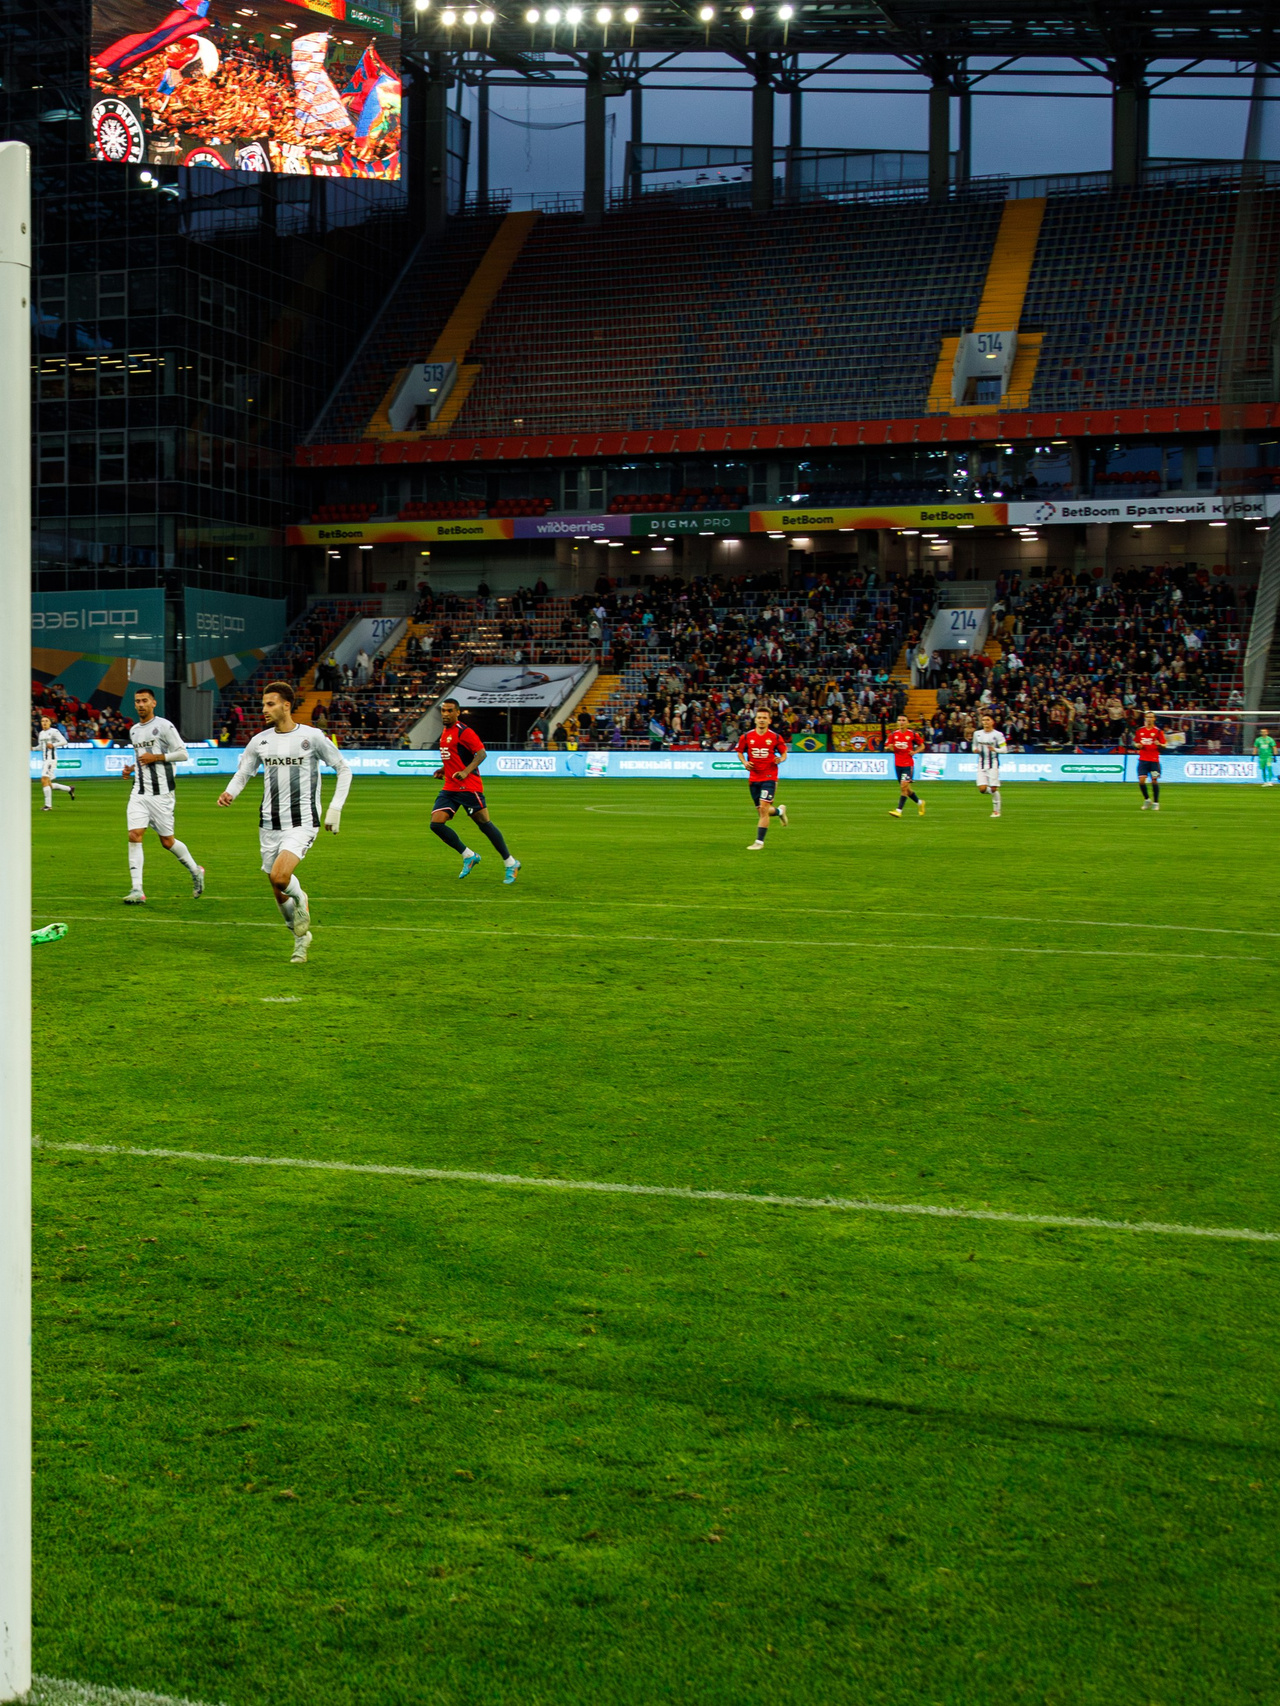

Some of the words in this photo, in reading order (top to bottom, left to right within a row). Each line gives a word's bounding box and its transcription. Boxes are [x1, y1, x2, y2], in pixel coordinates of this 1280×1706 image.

[977, 333, 1003, 353] 514
[423, 364, 445, 382] 513
[1061, 506, 1120, 518] BetBoom
[1126, 502, 1206, 517] Братский
[1212, 502, 1264, 517] кубок
[782, 515, 834, 525] BetBoom
[920, 511, 975, 521] BetBoom
[536, 520, 606, 533] wildberries
[650, 520, 698, 529] DIGMA
[703, 518, 731, 527] PRO
[318, 529, 363, 539] BetBoom
[437, 526, 484, 535] BetBoom
[950, 610, 977, 630] 214
[371, 619, 394, 637] 213
[751, 747, 770, 758] 25
[264, 756, 305, 766] MAXBET
[363, 757, 391, 768] ВКУС
[620, 758, 671, 770] НЕЖНЫЙ
[673, 760, 704, 770] ВКУС
[824, 760, 886, 774] СЕНЕЖСКАЯ
[1019, 763, 1053, 773] ВКУС
[1186, 763, 1255, 777] СЕНЕЖСКАЯ
